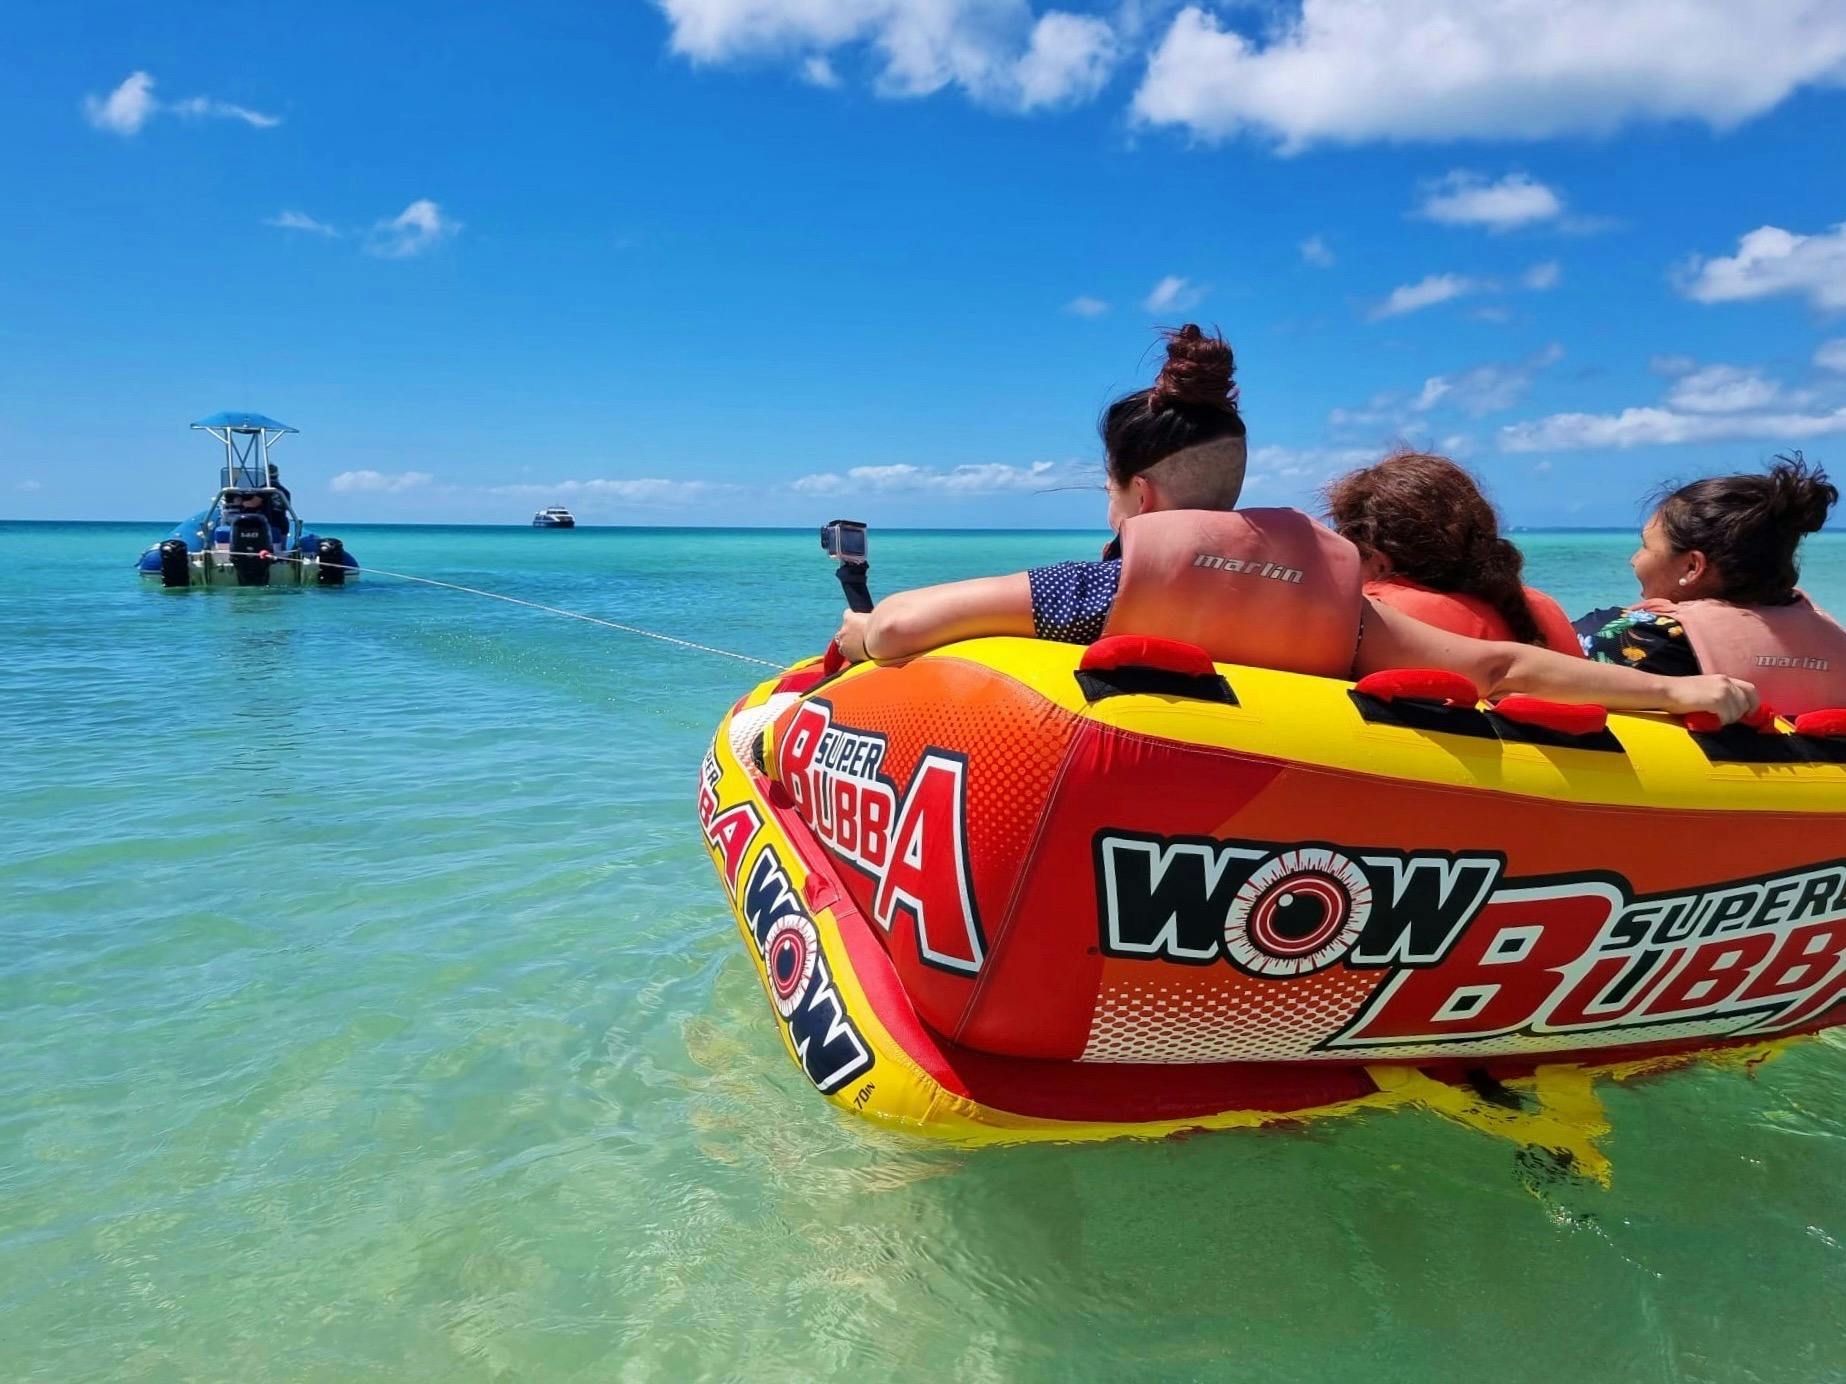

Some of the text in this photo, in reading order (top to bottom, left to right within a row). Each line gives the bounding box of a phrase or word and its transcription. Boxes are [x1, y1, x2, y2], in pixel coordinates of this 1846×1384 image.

[1193, 552, 1304, 584] marlin
[1756, 655, 1829, 672] marlin
[815, 732, 884, 781] SUPER
[782, 699, 985, 973] BUBBA
[1098, 834, 1502, 976] WOW
[1600, 873, 1842, 951] SUPER
[744, 846, 872, 1094] WOW
